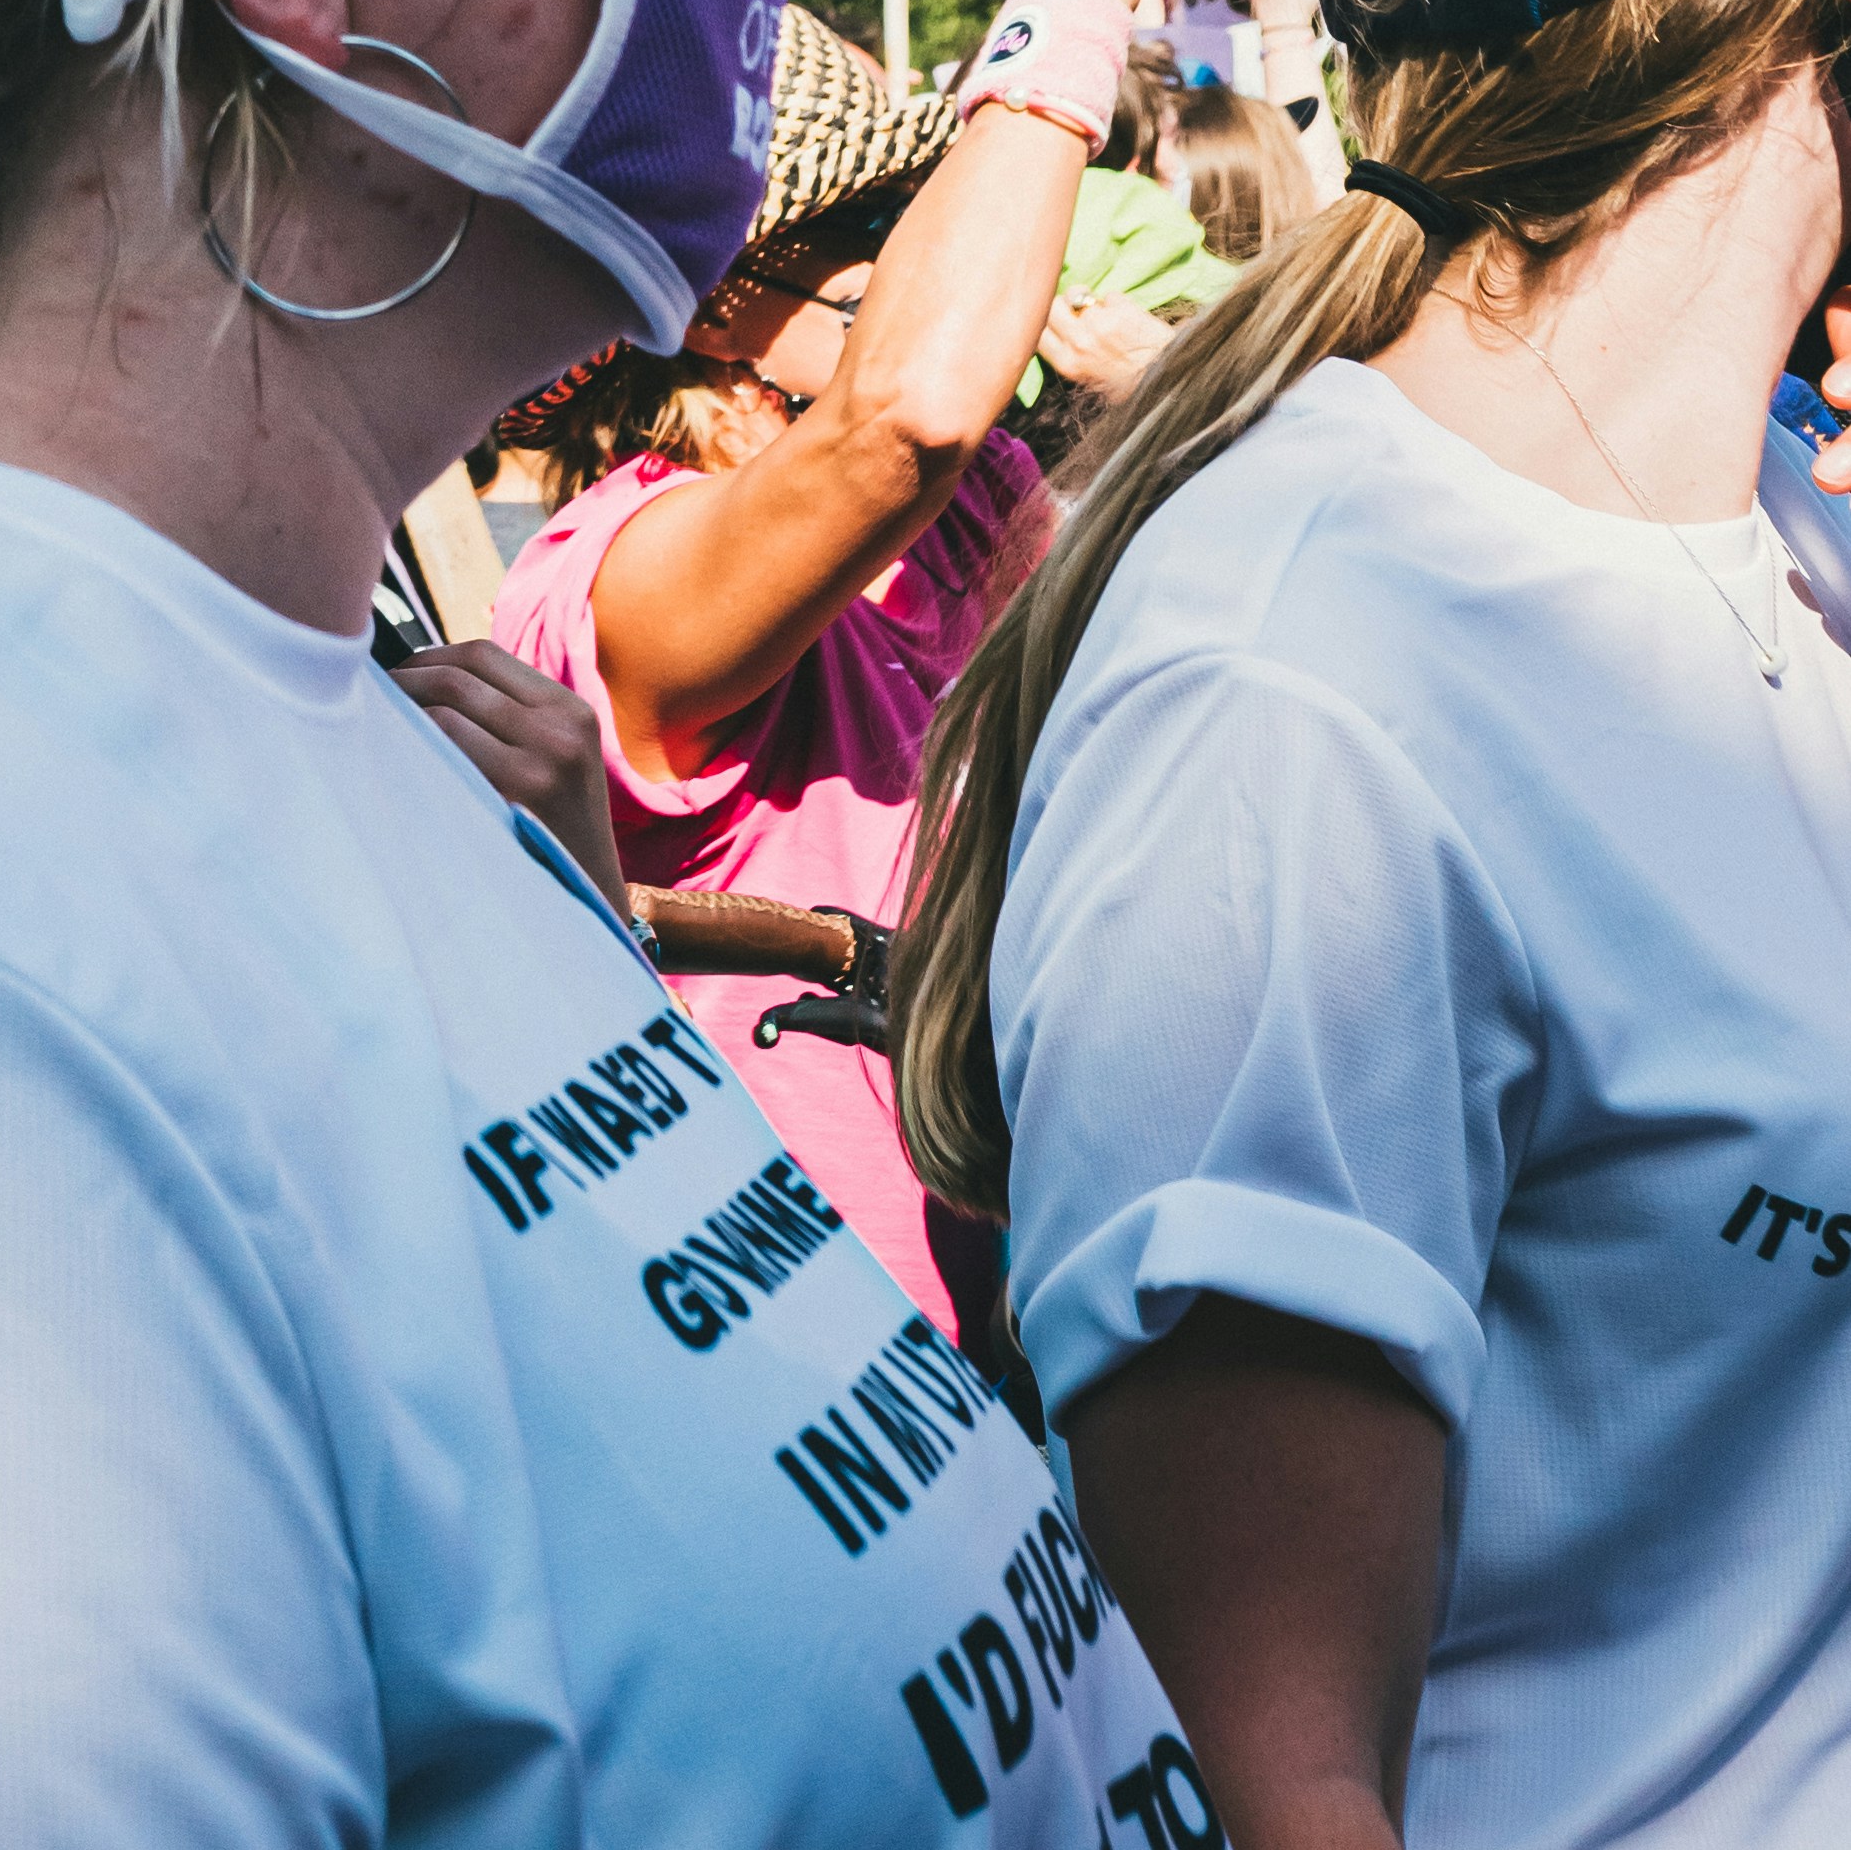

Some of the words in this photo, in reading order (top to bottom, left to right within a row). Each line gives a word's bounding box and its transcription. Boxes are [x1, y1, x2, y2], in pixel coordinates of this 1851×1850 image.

[463, 1120, 554, 1235] IF
[1720, 1183, 1851, 1278] IT'S
[774, 1404, 912, 1559] IN
[900, 1609, 1034, 1823] I'D
